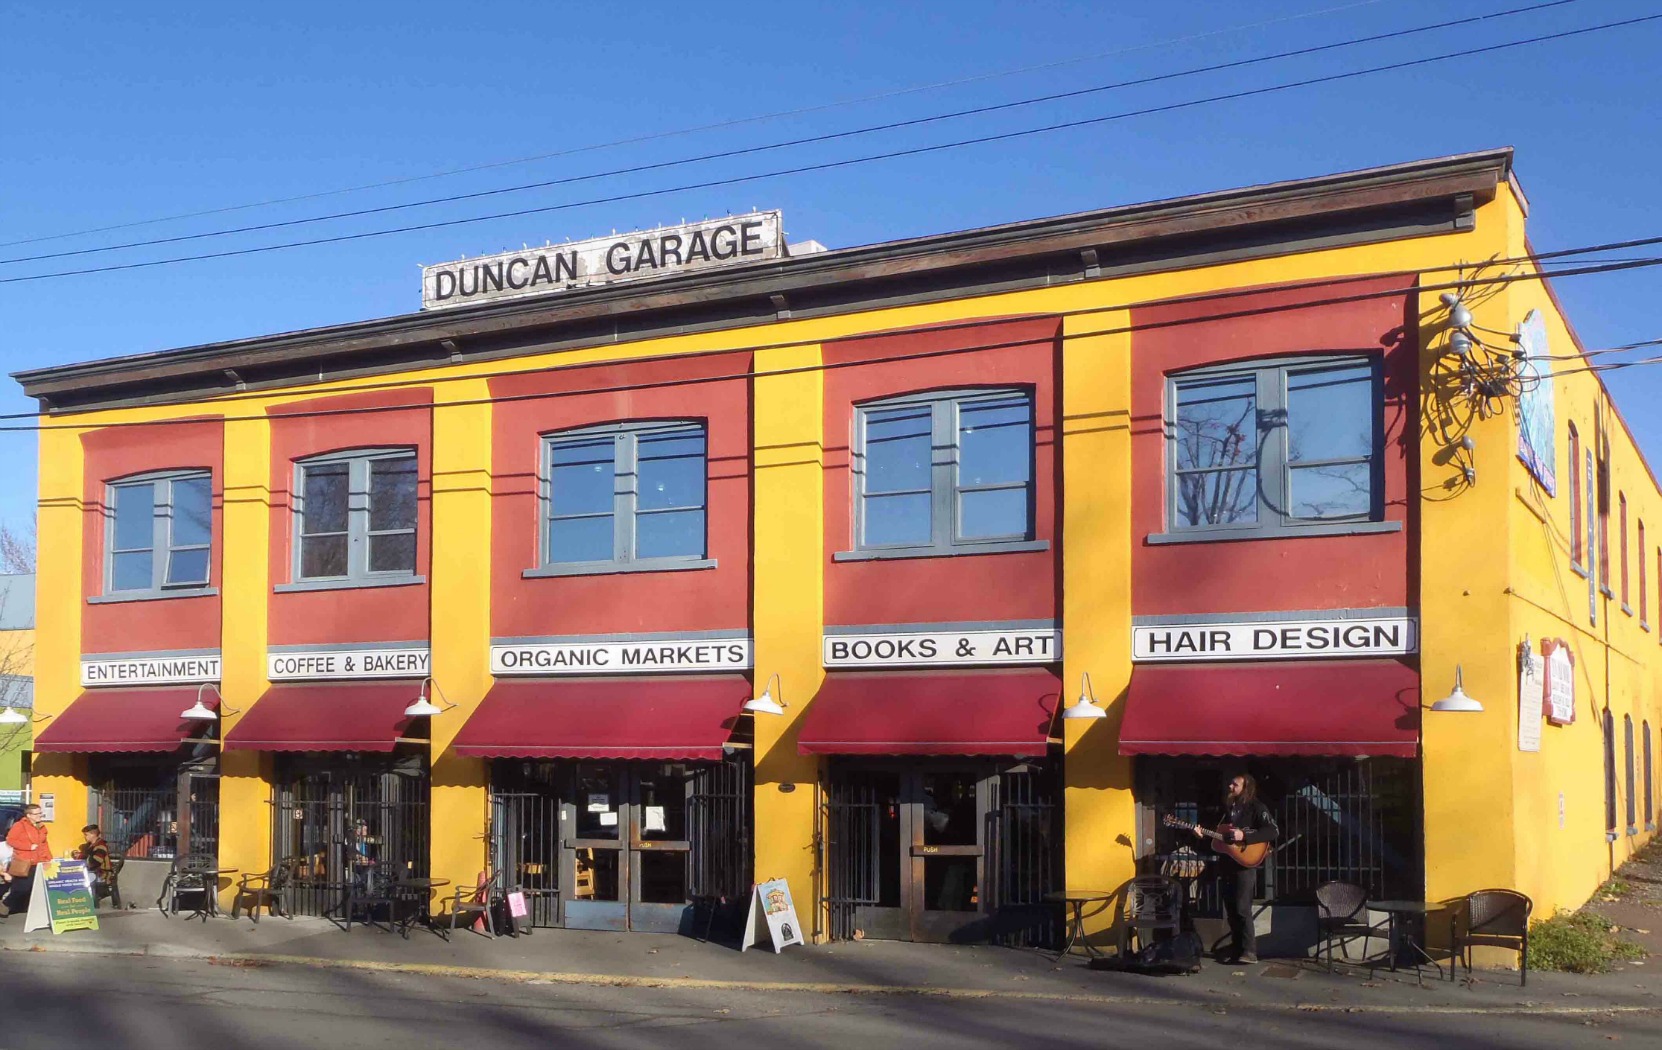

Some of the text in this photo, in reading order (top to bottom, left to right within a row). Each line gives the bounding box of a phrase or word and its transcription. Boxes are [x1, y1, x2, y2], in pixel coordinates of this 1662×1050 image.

[435, 221, 764, 301] DUNCAN GARAGE
[831, 635, 1054, 660] BOOKS & ART
[1148, 625, 1399, 653] HAIR DESIGN
[274, 653, 429, 674] COFFEE & BAKERY
[500, 644, 744, 667] ORGANIC MARKETS
[87, 660, 219, 680] ENTERTAINMENT
